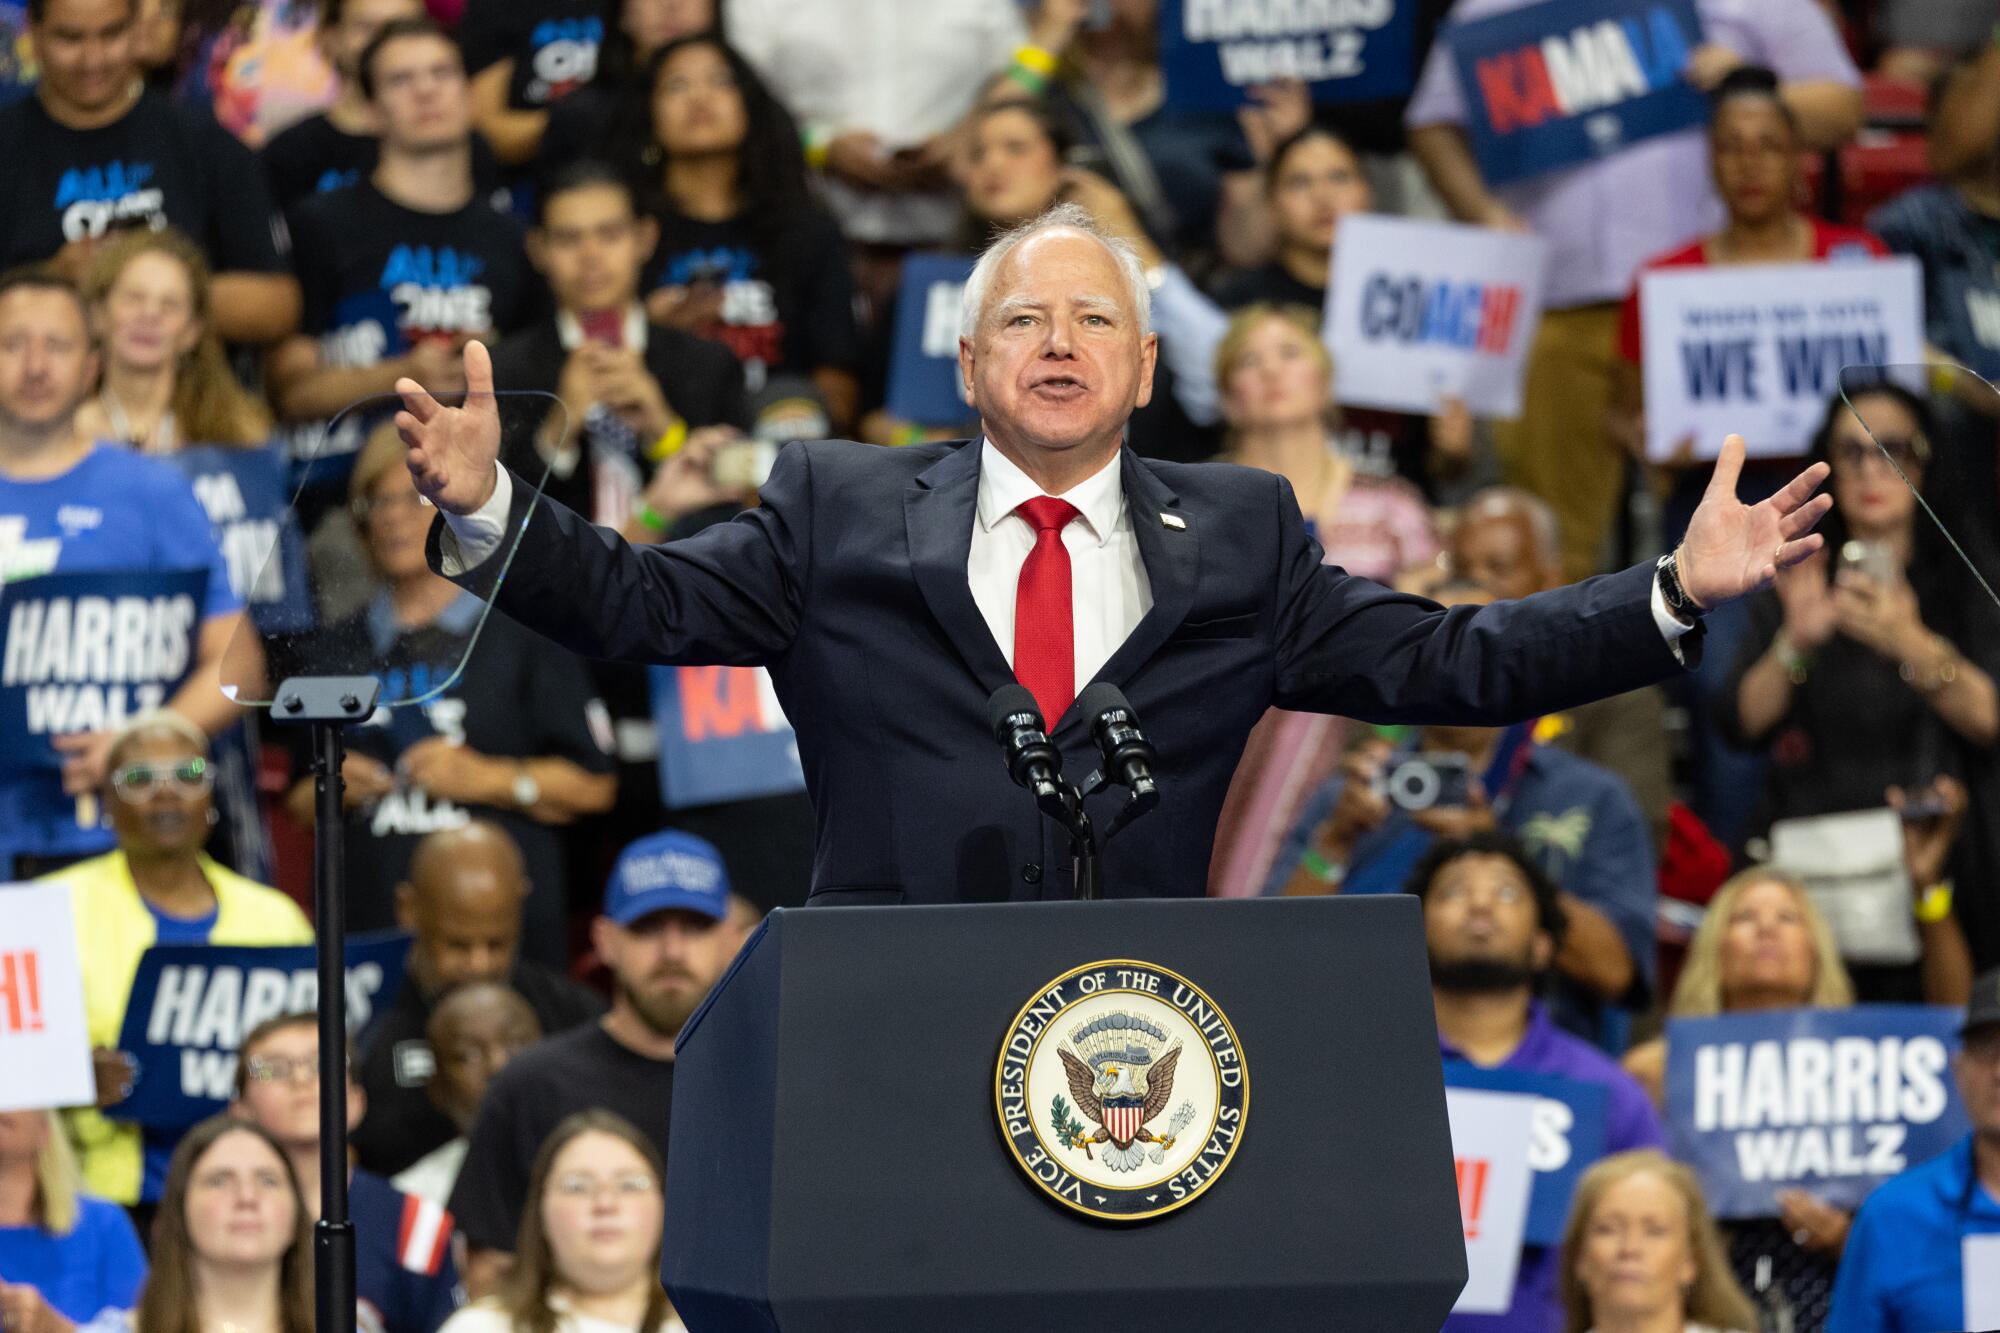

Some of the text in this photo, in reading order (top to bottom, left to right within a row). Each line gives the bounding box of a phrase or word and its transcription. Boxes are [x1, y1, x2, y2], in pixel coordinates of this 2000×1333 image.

[1218, 31, 1366, 86] WALZ
[1681, 336, 1758, 402] WE
[3, 593, 195, 687] HARRIS
[1001, 970, 1242, 1205] VICE PRESIDENT OF THE UNITED STATES
[1694, 1034, 1948, 1133] HARRIS
[1735, 1122, 1907, 1183] WALZ
